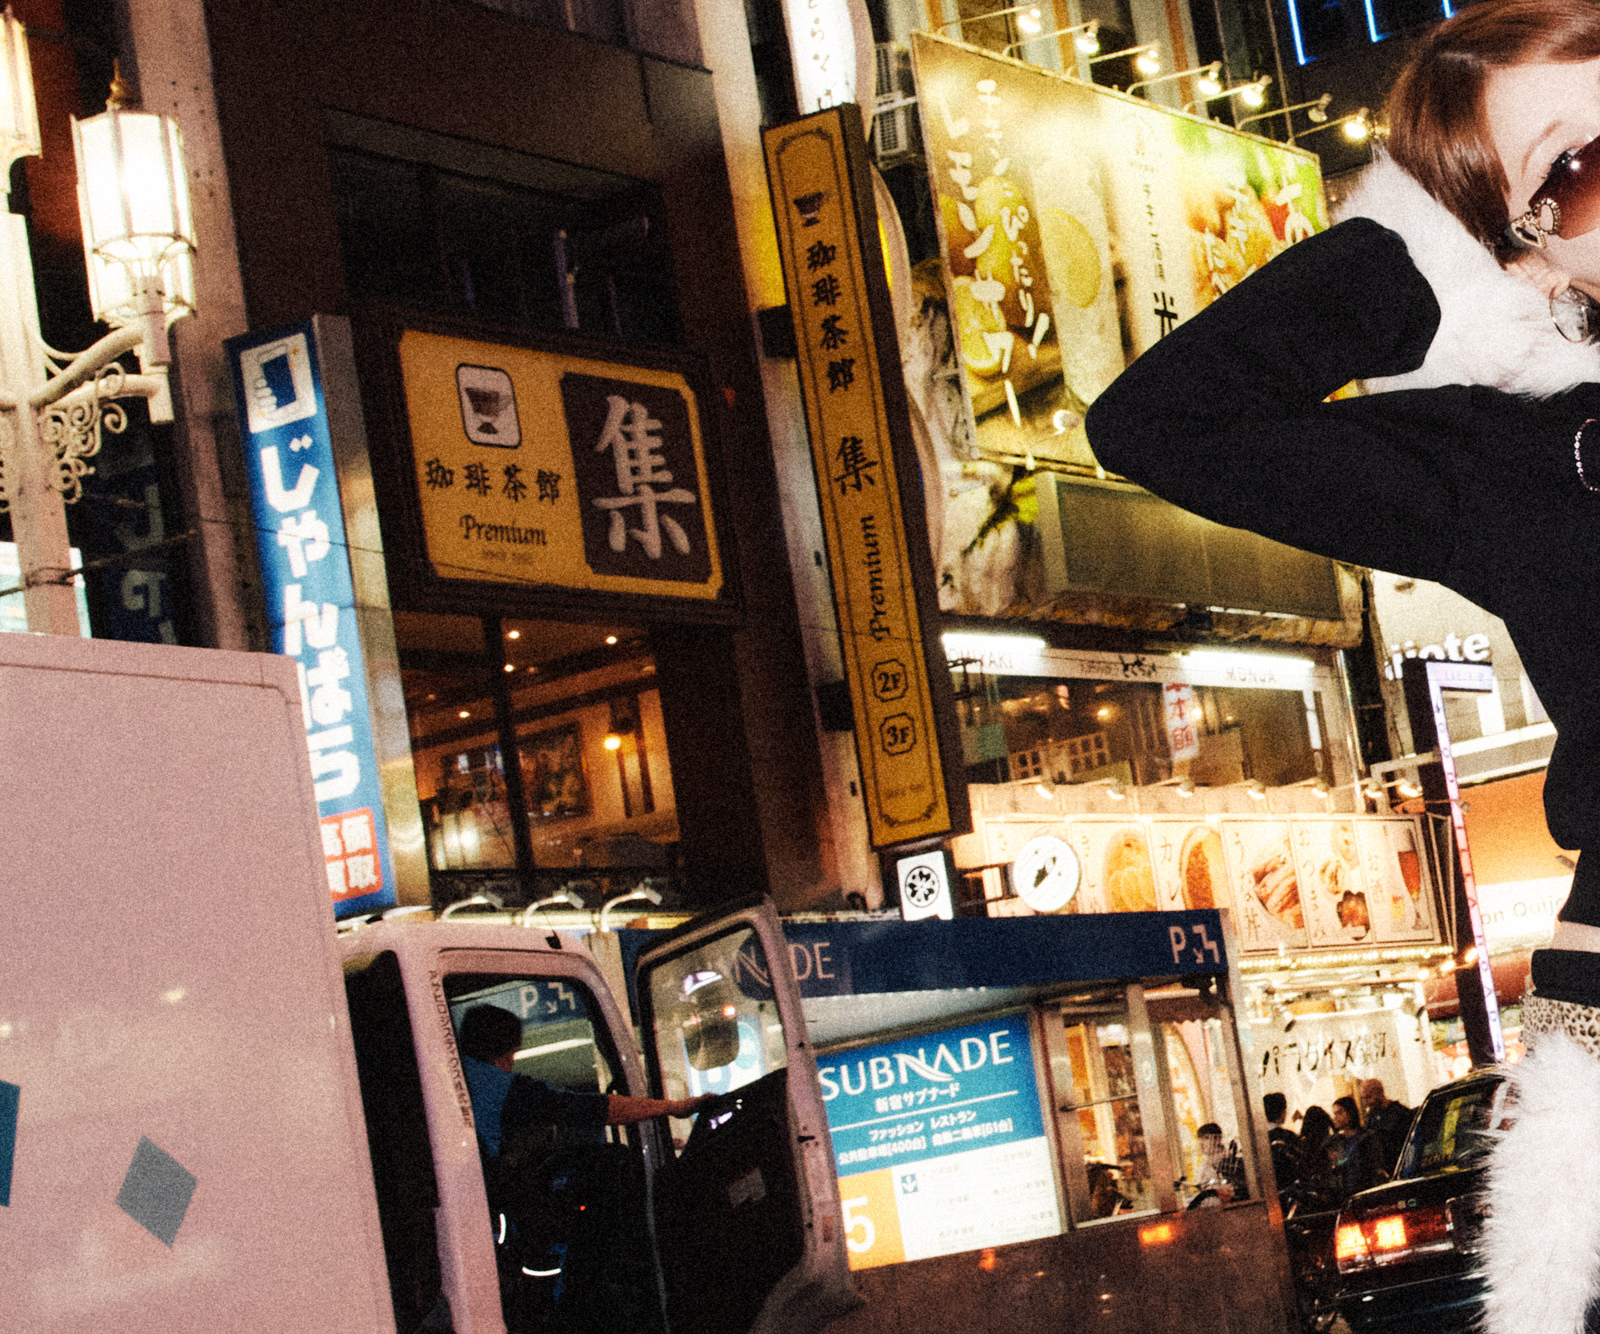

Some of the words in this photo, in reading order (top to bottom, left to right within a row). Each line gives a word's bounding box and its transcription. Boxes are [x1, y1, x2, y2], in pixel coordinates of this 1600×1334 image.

[425, 458, 561, 505] 珈琲茶館
[592, 394, 697, 559] 集
[459, 515, 547, 546] Premium
[860, 515, 892, 643] Premium
[877, 671, 901, 694] 2F
[886, 724, 910, 748] 3F
[818, 1030, 1014, 1101] SUBNADE
[875, 1082, 960, 1114] 新宿サブナード
[869, 1121, 925, 1143] ファッション
[930, 1110, 977, 1130] レストラン
[842, 1197, 876, 1254] 5
